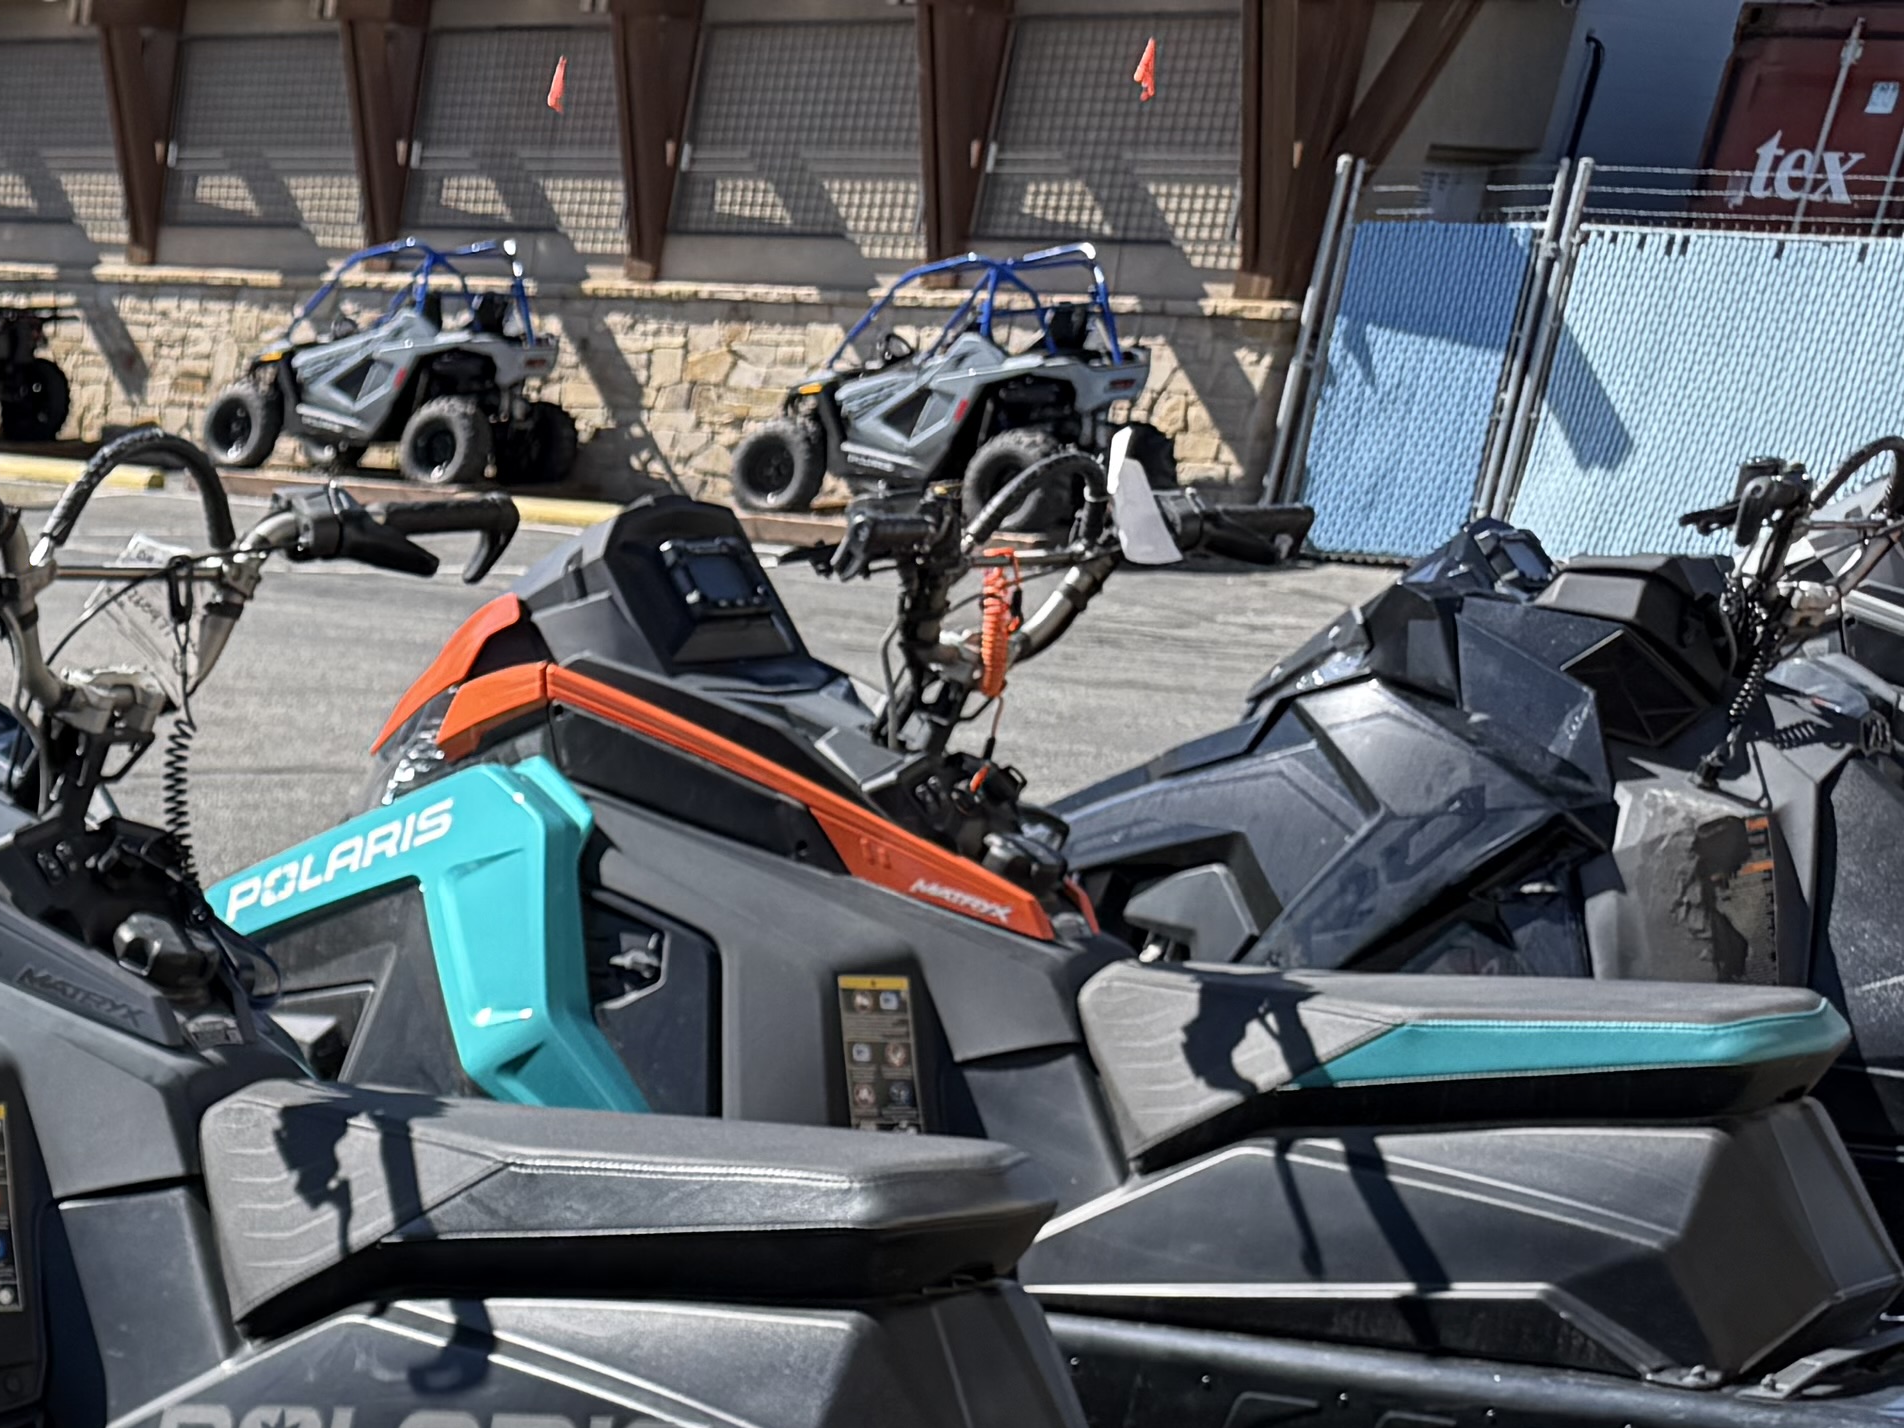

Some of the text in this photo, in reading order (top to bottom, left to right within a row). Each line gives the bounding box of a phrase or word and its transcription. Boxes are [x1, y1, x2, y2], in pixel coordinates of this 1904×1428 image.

[1749, 129, 1866, 205] tex
[226, 797, 455, 923] POLARIS
[16, 966, 147, 1029] MATRYX
